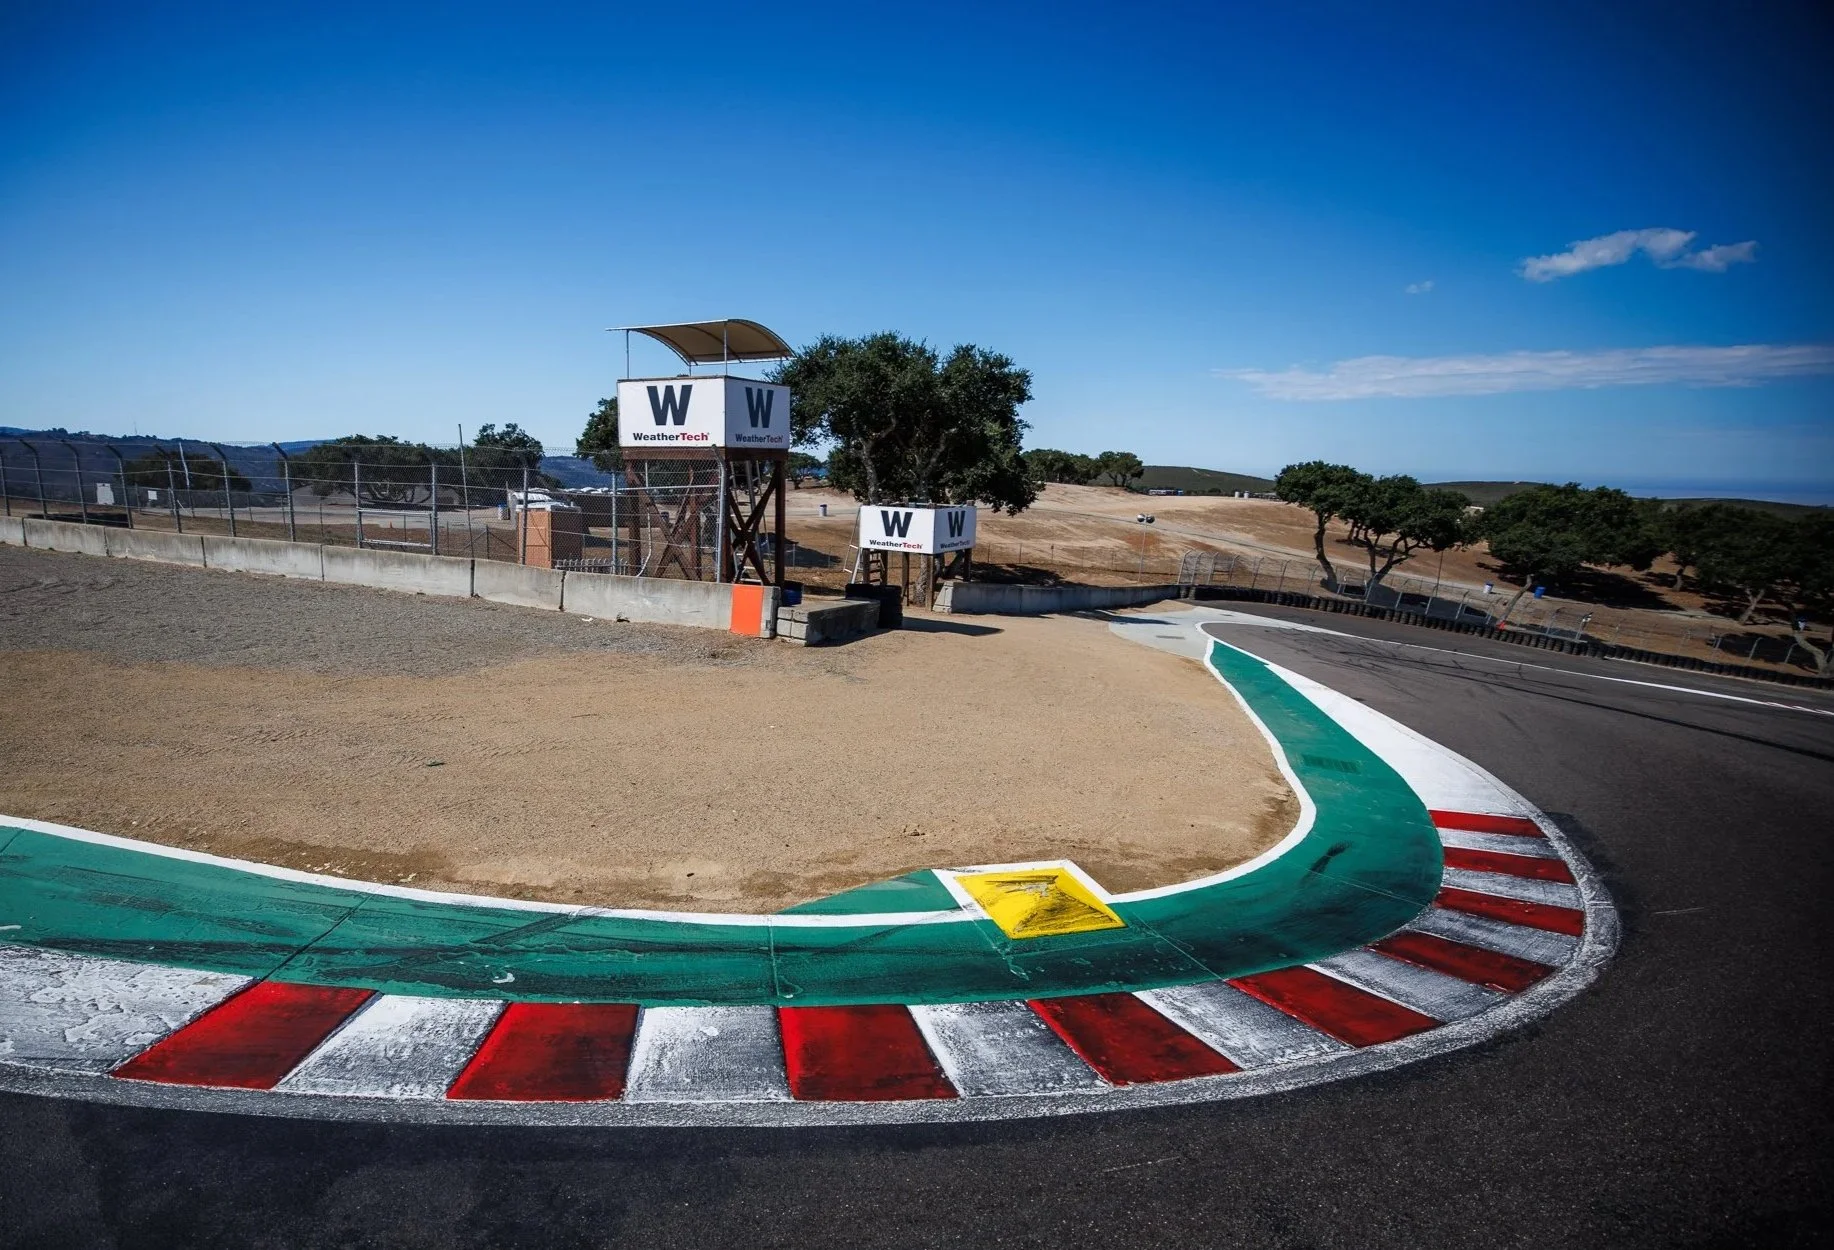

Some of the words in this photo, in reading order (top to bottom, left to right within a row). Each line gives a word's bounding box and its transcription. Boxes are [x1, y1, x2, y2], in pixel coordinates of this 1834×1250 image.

[647, 384, 692, 426] W
[745, 386, 774, 428] W
[633, 432, 709, 441] WeatherTech
[735, 433, 783, 443] WeatherTech
[881, 510, 913, 538] W
[947, 510, 966, 538] W
[869, 539, 922, 549] WeatherTech
